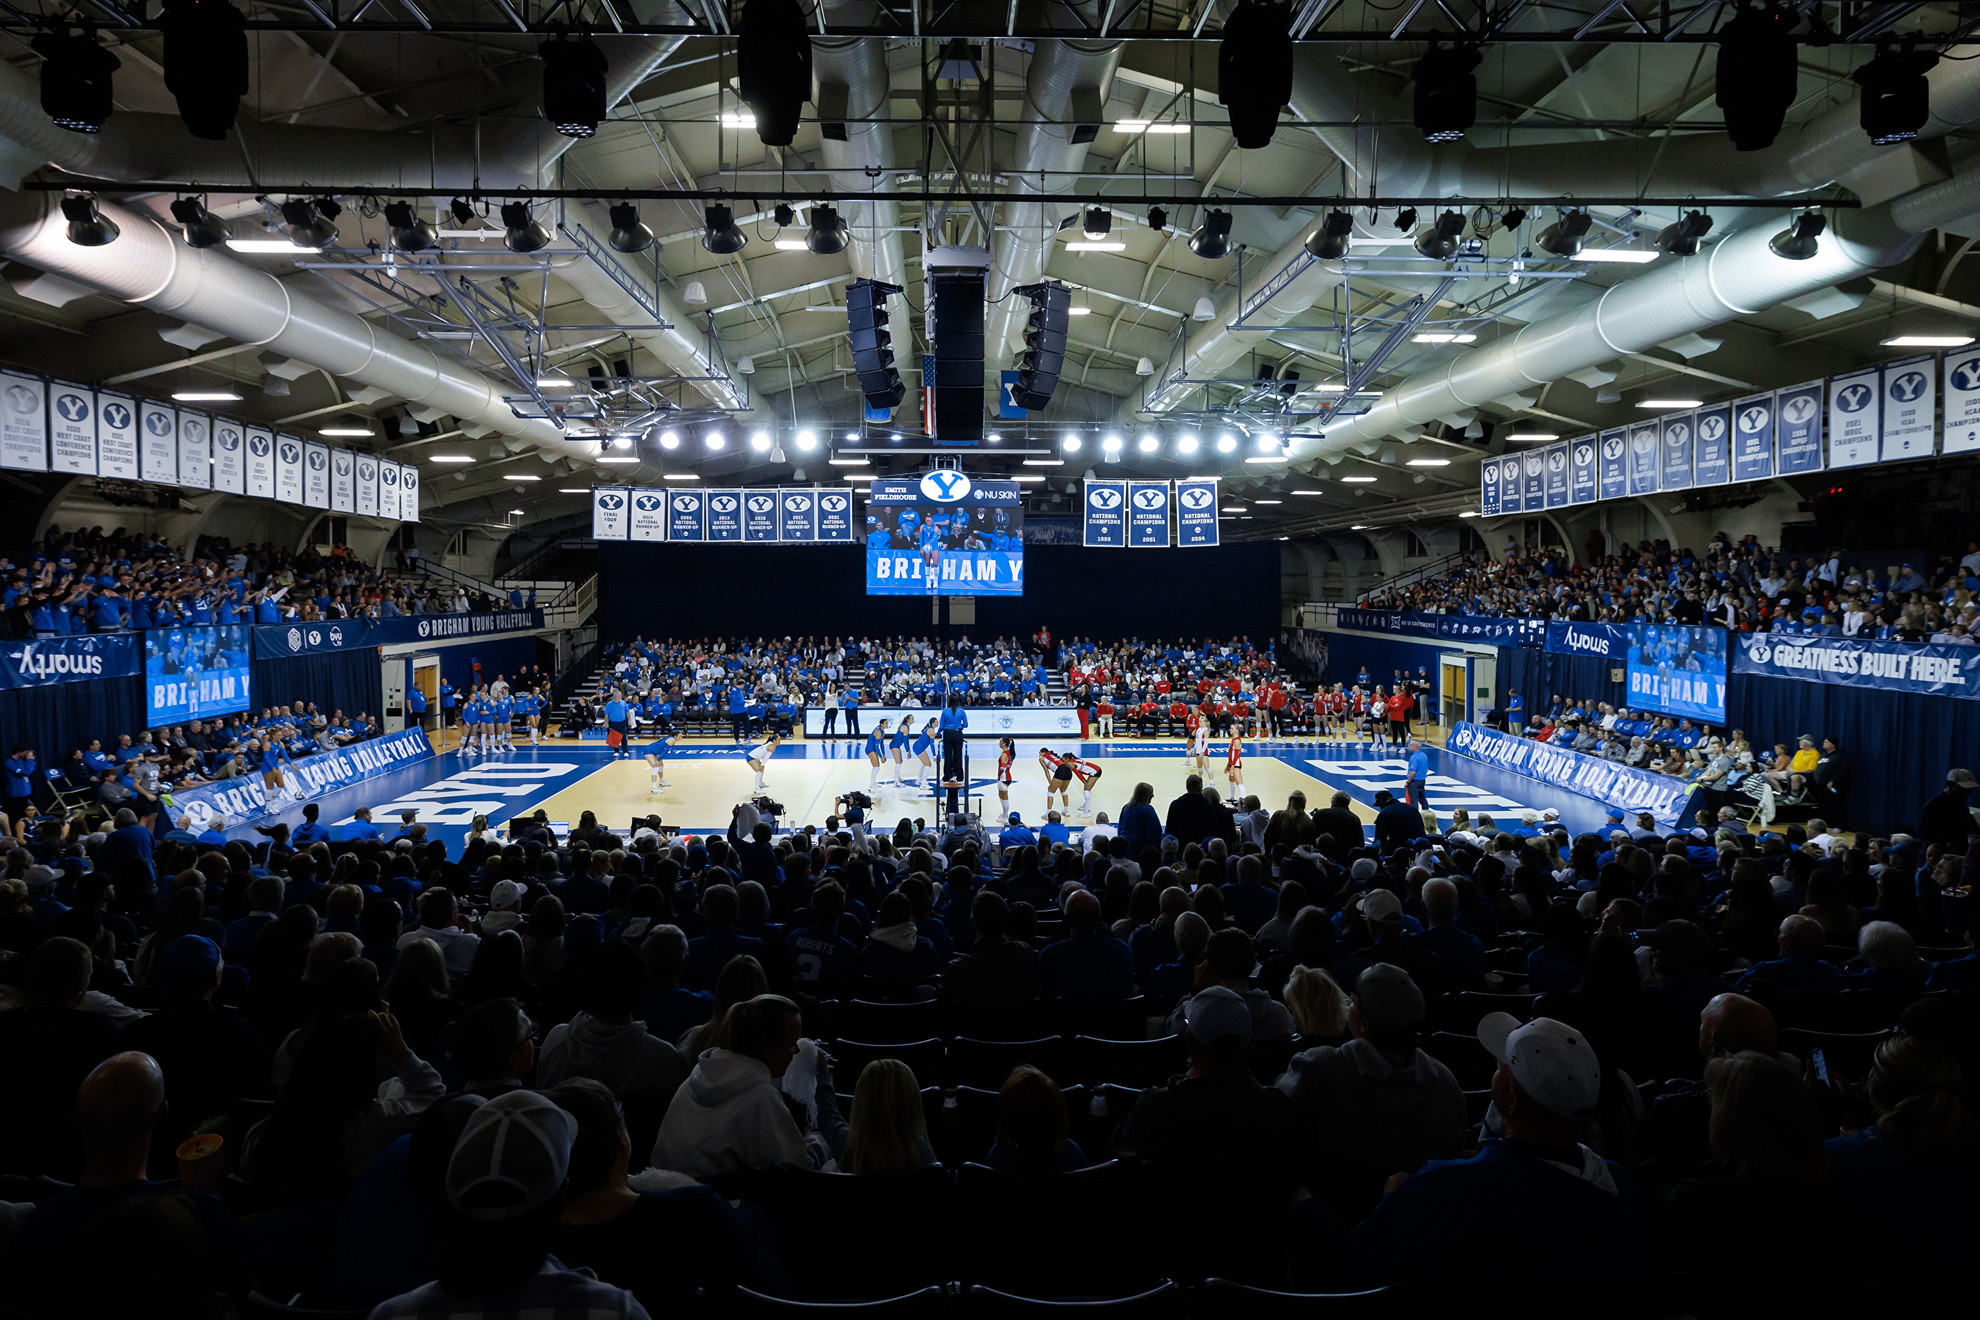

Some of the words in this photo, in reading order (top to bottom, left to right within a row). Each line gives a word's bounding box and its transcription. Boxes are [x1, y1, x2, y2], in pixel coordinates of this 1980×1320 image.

[56, 432, 71, 440] WEST
[73, 434, 91, 443] COAST
[56, 440, 92, 451] CONFERENCE
[103, 439, 116, 447] WEST
[1834, 434, 1872, 446] CHAMPIONS
[57, 448, 91, 459] CHAMPIONS
[102, 446, 133, 457] CONFERENCE
[103, 454, 133, 465] CHAMPIONS
[876, 557, 996, 581] BRIHAM
[432, 617, 469, 636] BRIGHAM
[471, 614, 494, 632] YOUNG
[496, 612, 532, 630] VOLLEYBALL
[1564, 626, 1610, 655] smarty
[19, 645, 103, 679] smarty
[1773, 644, 1858, 674] GREATNESS
[1860, 652, 1910, 680] BUILT
[1910, 656, 1966, 684] HERE.
[153, 676, 235, 708] BRIHAM
[1632, 672, 1708, 705] BRIHAM
[300, 756, 352, 789] YOUNG
[350, 734, 427, 772] VOLLEYBALL
[1471, 734, 1528, 766] BRIGHAM
[1575, 762, 1679, 815] VOLLEYBALL
[331, 762, 579, 826] BYU
[795, 936, 836, 955] ROBERTS
